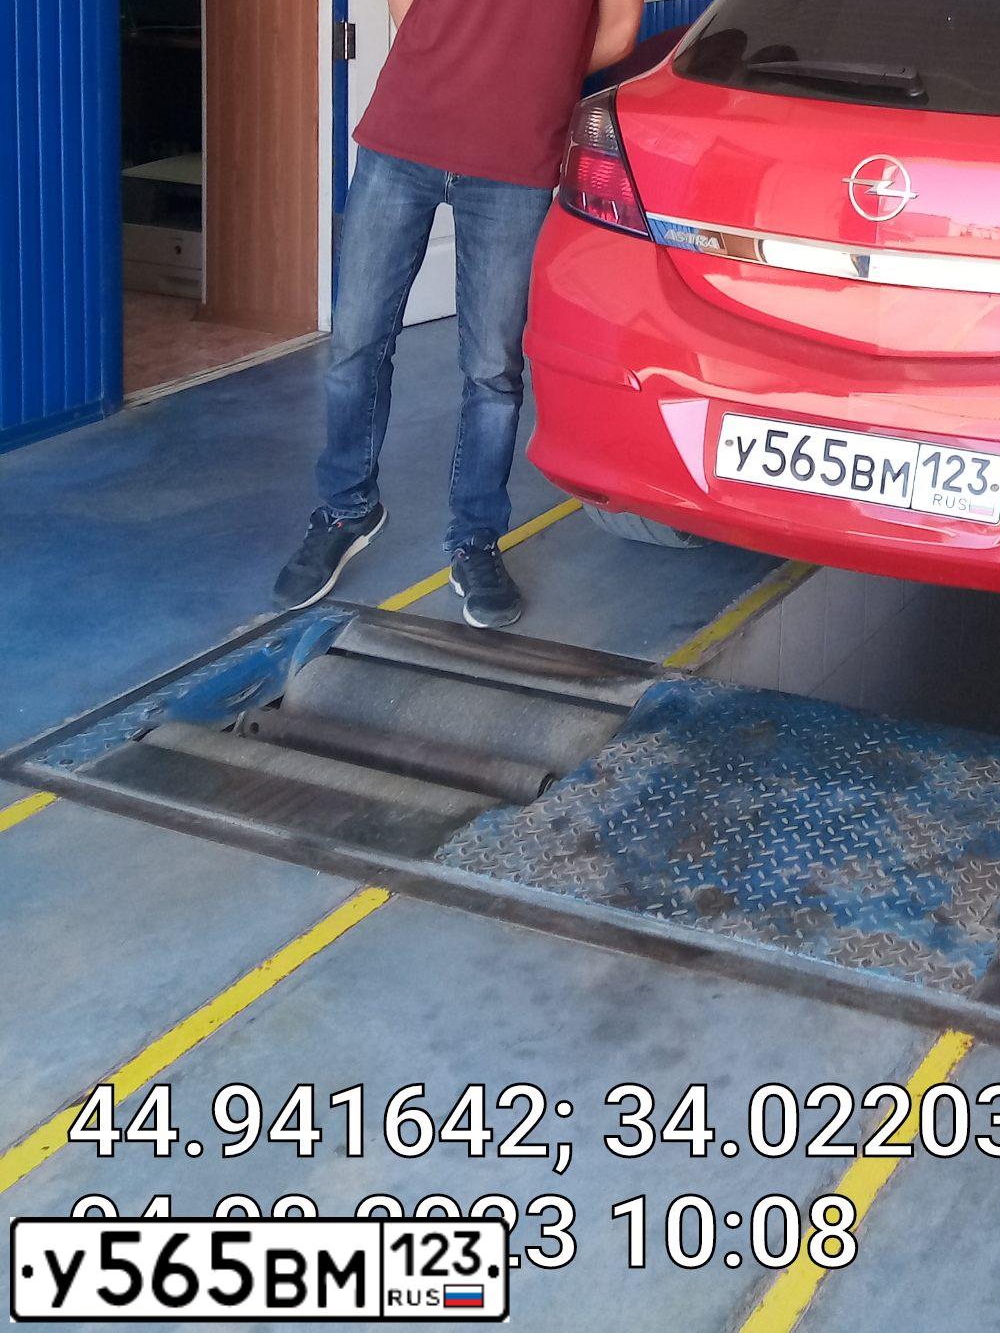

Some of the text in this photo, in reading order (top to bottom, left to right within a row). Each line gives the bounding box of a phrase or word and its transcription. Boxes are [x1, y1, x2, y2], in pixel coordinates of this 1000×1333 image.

[664, 229, 720, 250] ASTRA
[922, 451, 991, 496] 123
[932, 494, 968, 511] RUS
